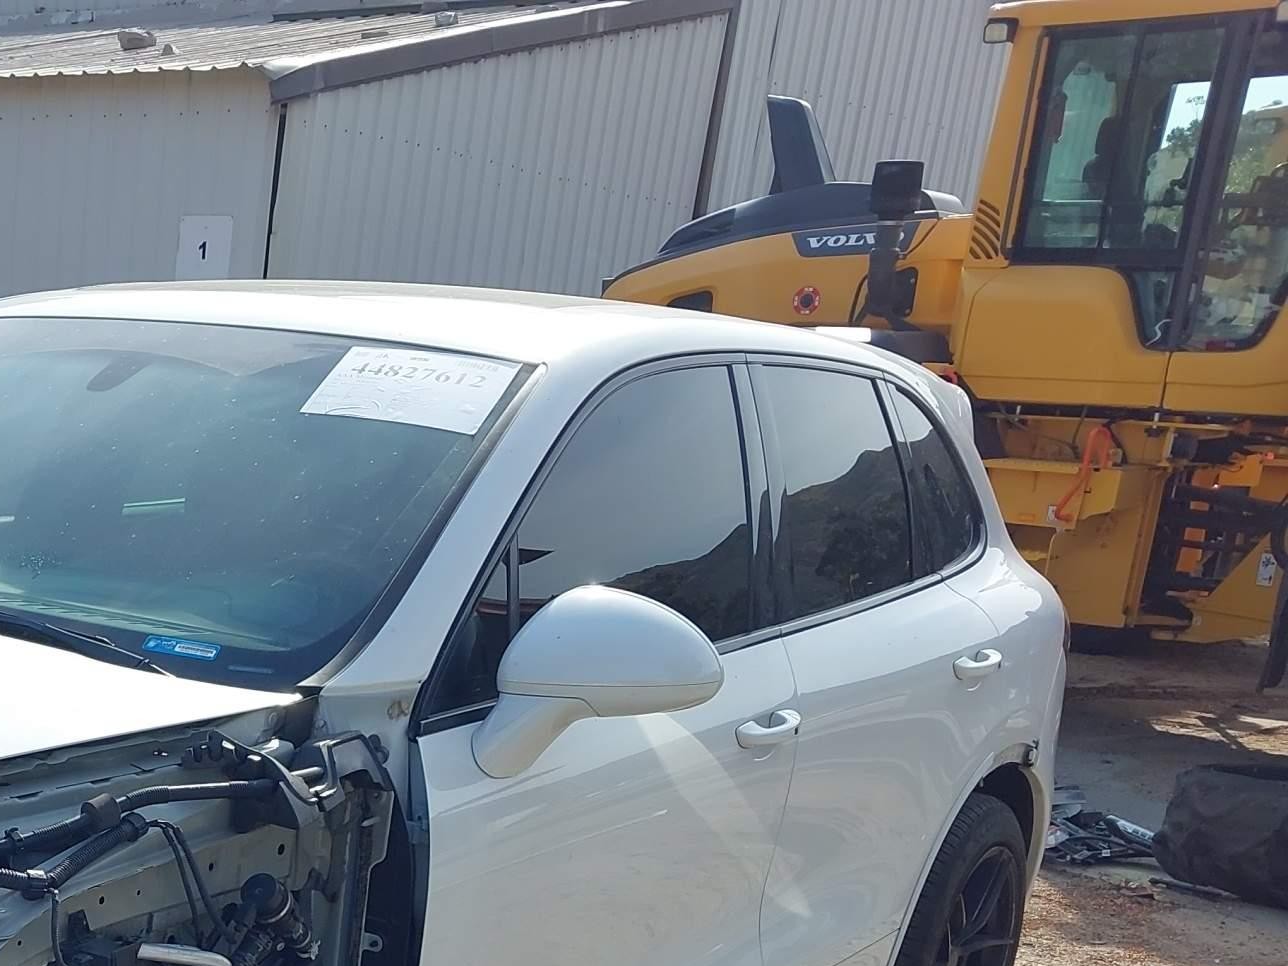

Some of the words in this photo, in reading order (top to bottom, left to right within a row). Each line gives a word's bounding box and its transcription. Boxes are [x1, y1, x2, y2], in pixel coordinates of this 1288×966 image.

[198, 240, 207, 260] 1
[806, 231, 905, 250] VOLV
[352, 362, 487, 388] 44827612
